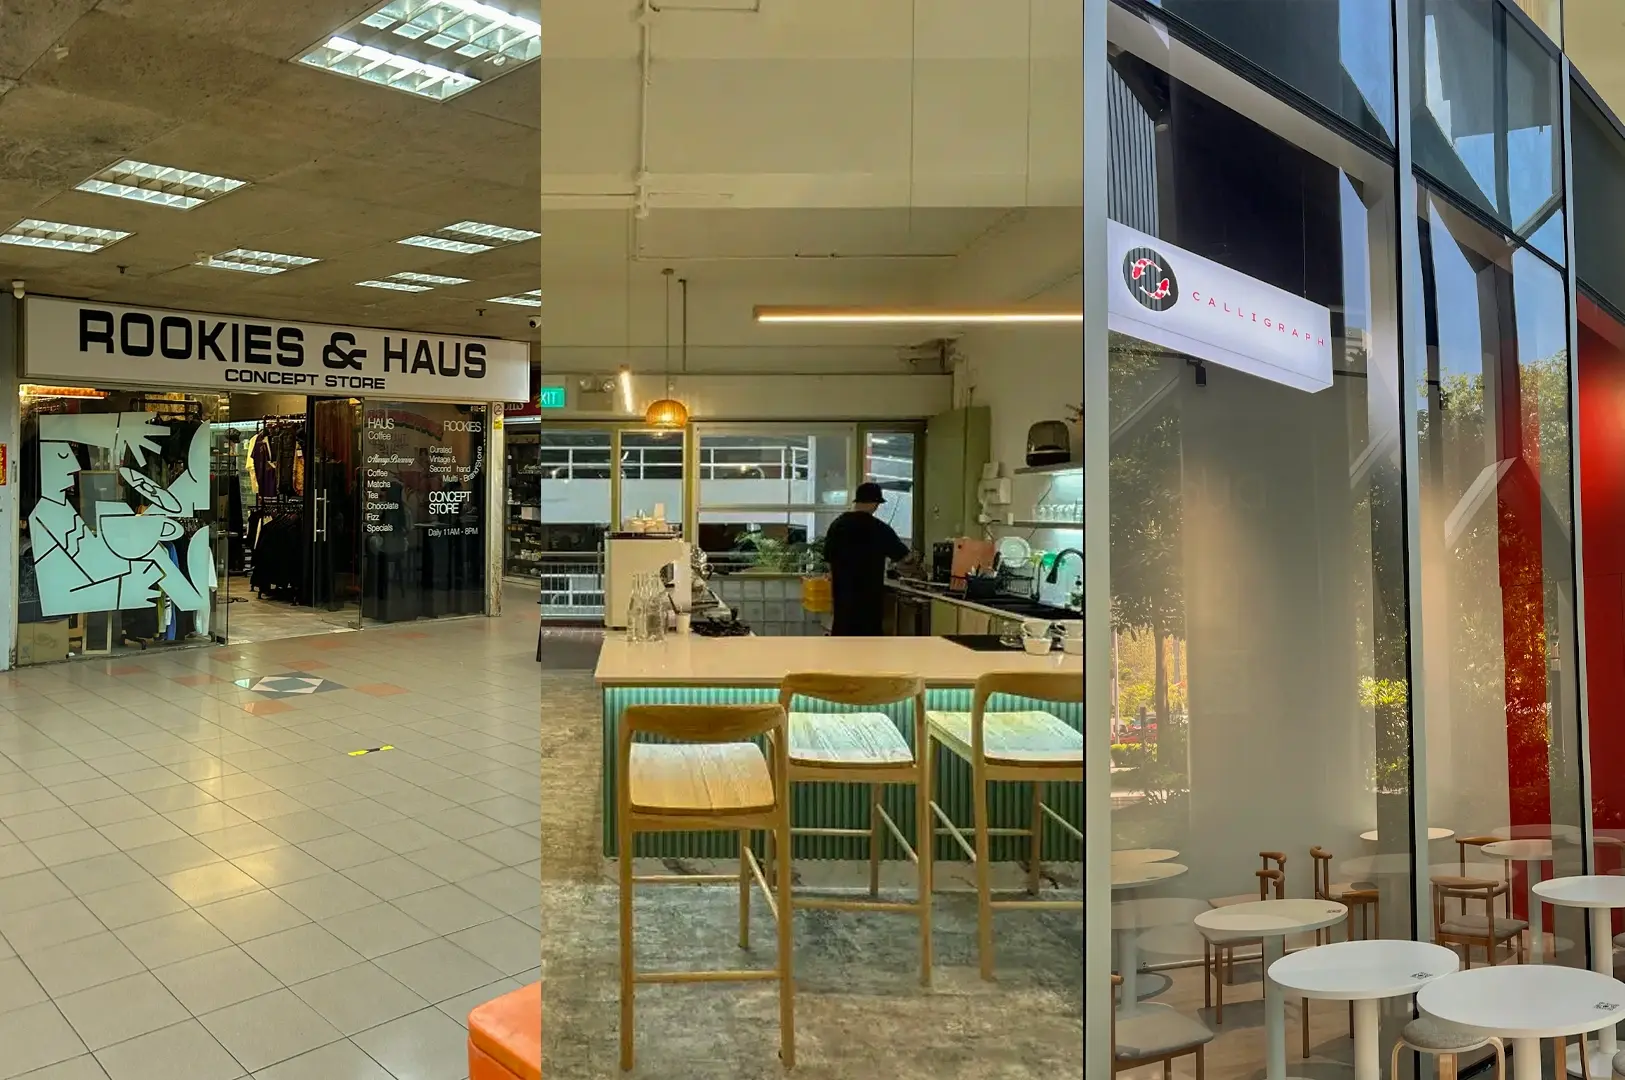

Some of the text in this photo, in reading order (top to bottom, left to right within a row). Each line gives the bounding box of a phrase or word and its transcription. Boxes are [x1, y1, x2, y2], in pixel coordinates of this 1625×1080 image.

[1192, 291, 1325, 347] CALLIGRAPH
[79, 308, 486, 378] ROOKIES & HAUS
[225, 369, 385, 390] CONCEPT STORE
[368, 418, 395, 430] HAUS
[443, 420, 482, 433] ROOKIES
[368, 431, 391, 441] Coffee
[429, 445, 453, 454] Curated
[429, 455, 451, 465] Vintage
[367, 468, 388, 478] Coffee
[429, 465, 471, 473] Second hand
[442, 475, 459, 483] Multi
[367, 480, 391, 489] Matcha
[367, 491, 379, 499] Tea
[428, 490, 472, 502] CONCEPT
[366, 502, 399, 510] Chocolate
[428, 503, 459, 515] STORE
[366, 513, 380, 521] Fizz
[366, 523, 393, 534] Specials
[428, 528, 443, 538] Daily
[443, 528, 460, 536] 11AM
[464, 527, 479, 535] 8PM
